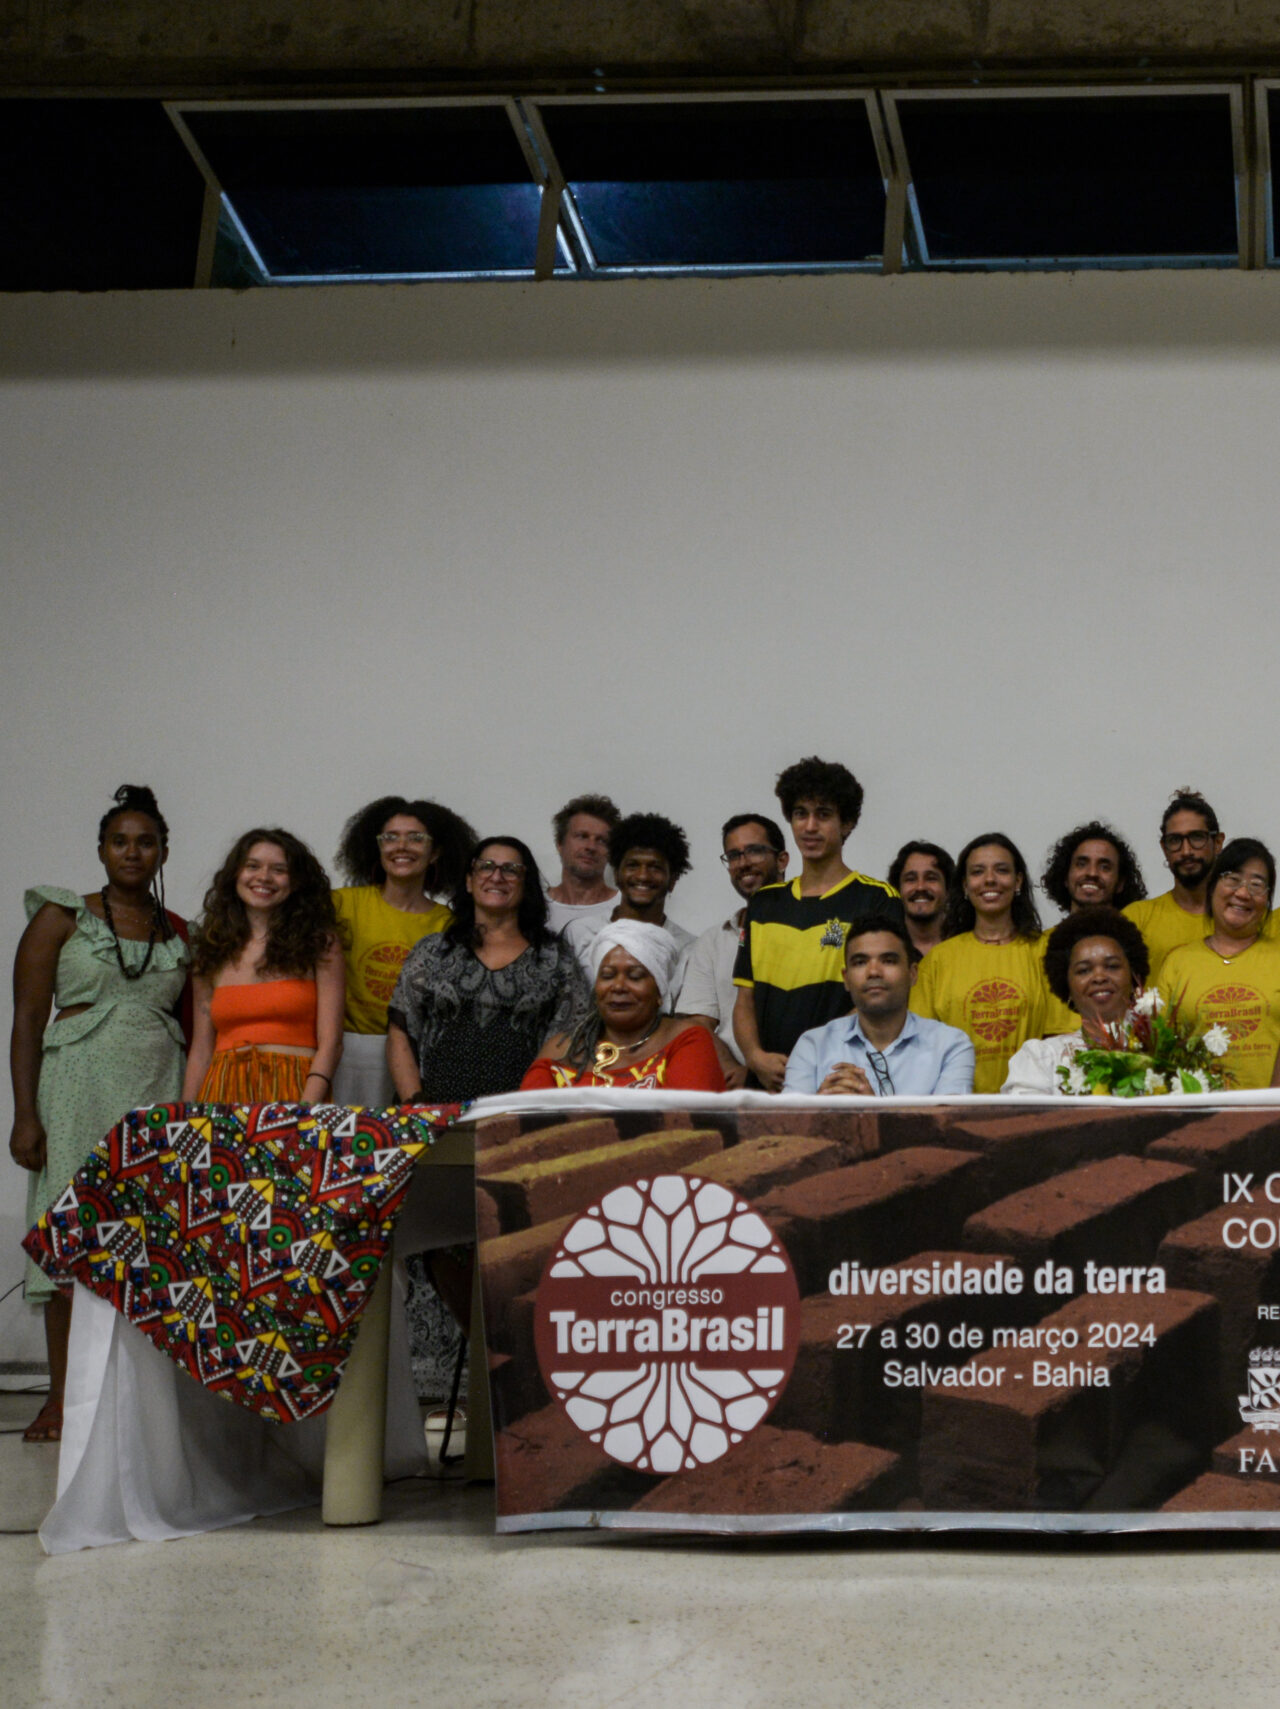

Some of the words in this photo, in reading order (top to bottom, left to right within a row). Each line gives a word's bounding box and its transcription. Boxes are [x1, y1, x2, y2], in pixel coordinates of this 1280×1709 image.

[1224, 1174, 1254, 1202] IX
[829, 1261, 1023, 1295] diversidade
[1034, 1261, 1073, 1294] da
[1084, 1261, 1166, 1294] terra
[611, 1289, 723, 1309] congresso
[550, 1307, 784, 1353] TerraBrasil
[837, 1324, 871, 1348] 27
[881, 1329, 897, 1348] a
[906, 1324, 939, 1348] 30
[949, 1323, 983, 1348] de
[993, 1328, 1078, 1354] março
[1088, 1323, 1156, 1348] 2024
[884, 1361, 1006, 1387] Salvador
[1033, 1361, 1110, 1387] Bahia
